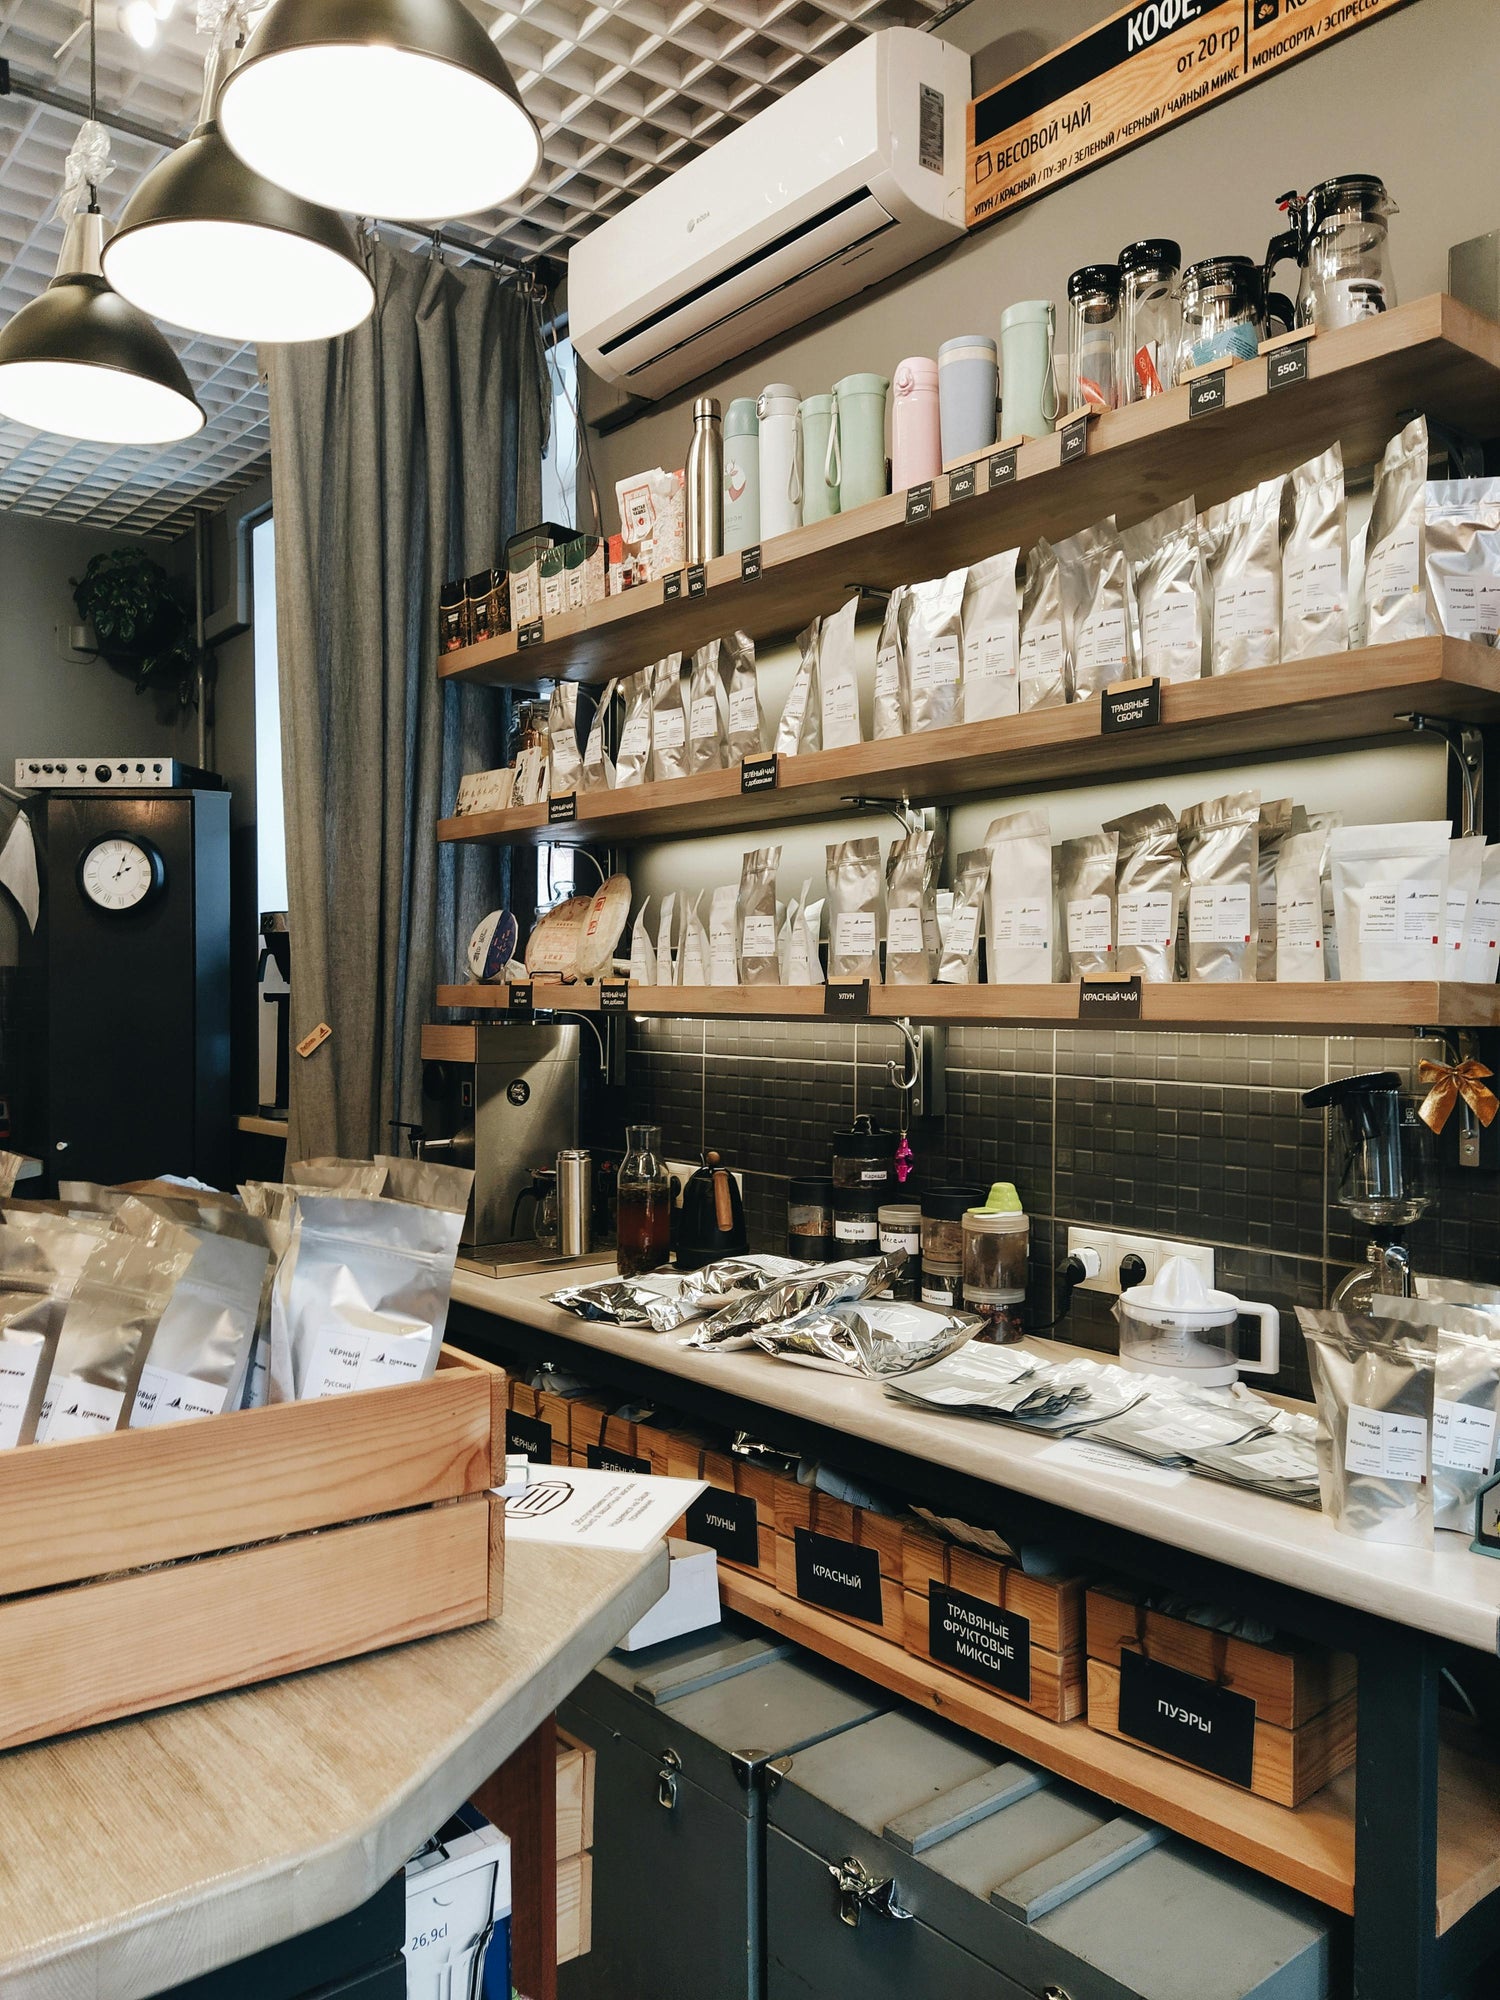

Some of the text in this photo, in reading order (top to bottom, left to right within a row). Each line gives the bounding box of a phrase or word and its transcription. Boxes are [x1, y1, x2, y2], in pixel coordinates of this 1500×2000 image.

[1177, 25, 1240, 74] от 20 гр
[1252, 25, 1315, 69] МОНОСОРТА
[974, 199, 993, 217] УЛУН
[999, 172, 1037, 204] КРАСНЫЙ
[1043, 156, 1067, 181] ПУ-ЭР
[1074, 130, 1115, 165] ЗЕЛЕНЫЙ
[1122, 107, 1160, 139] ЧЕРНЫЙ
[1167, 81, 1210, 114] ЧАЙНЫЙ
[1211, 65, 1239, 93] МИКС
[997, 120, 1058, 173] ВЕСОВОЙ
[1060, 101, 1091, 135] ЧАЙ
[1277, 360, 1302, 377] 550.-
[1197, 388, 1221, 404] 450.-
[1111, 698, 1149, 714] ТРАВЯНЫЕ
[1116, 710, 1143, 723] СБОРЫ
[838, 992, 855, 1000] УЛУН
[1083, 991, 1138, 1002] КРАСНЫЙ ЧАЙ
[329, 1346, 361, 1359] ЧЁРНЫЙ
[342, 1358, 358, 1368] ЧАЙ
[324, 1378, 351, 1390] Русский
[140, 1401, 154, 1412] ЧАЙ
[511, 1434, 538, 1453] ЧЁРНЫЙ
[705, 1513, 736, 1532] УЛУНЫ
[812, 1563, 862, 1590] КРАСНЫЙ
[946, 1603, 1010, 1641] ТРАВЯНЫЕ
[943, 1619, 1015, 1660] ФРУКТОВЫЕ
[956, 1640, 1001, 1671] МИКСЫ
[1157, 1699, 1212, 1734] ПУЭРЫ
[411, 1922, 448, 1951] 26,9cl
